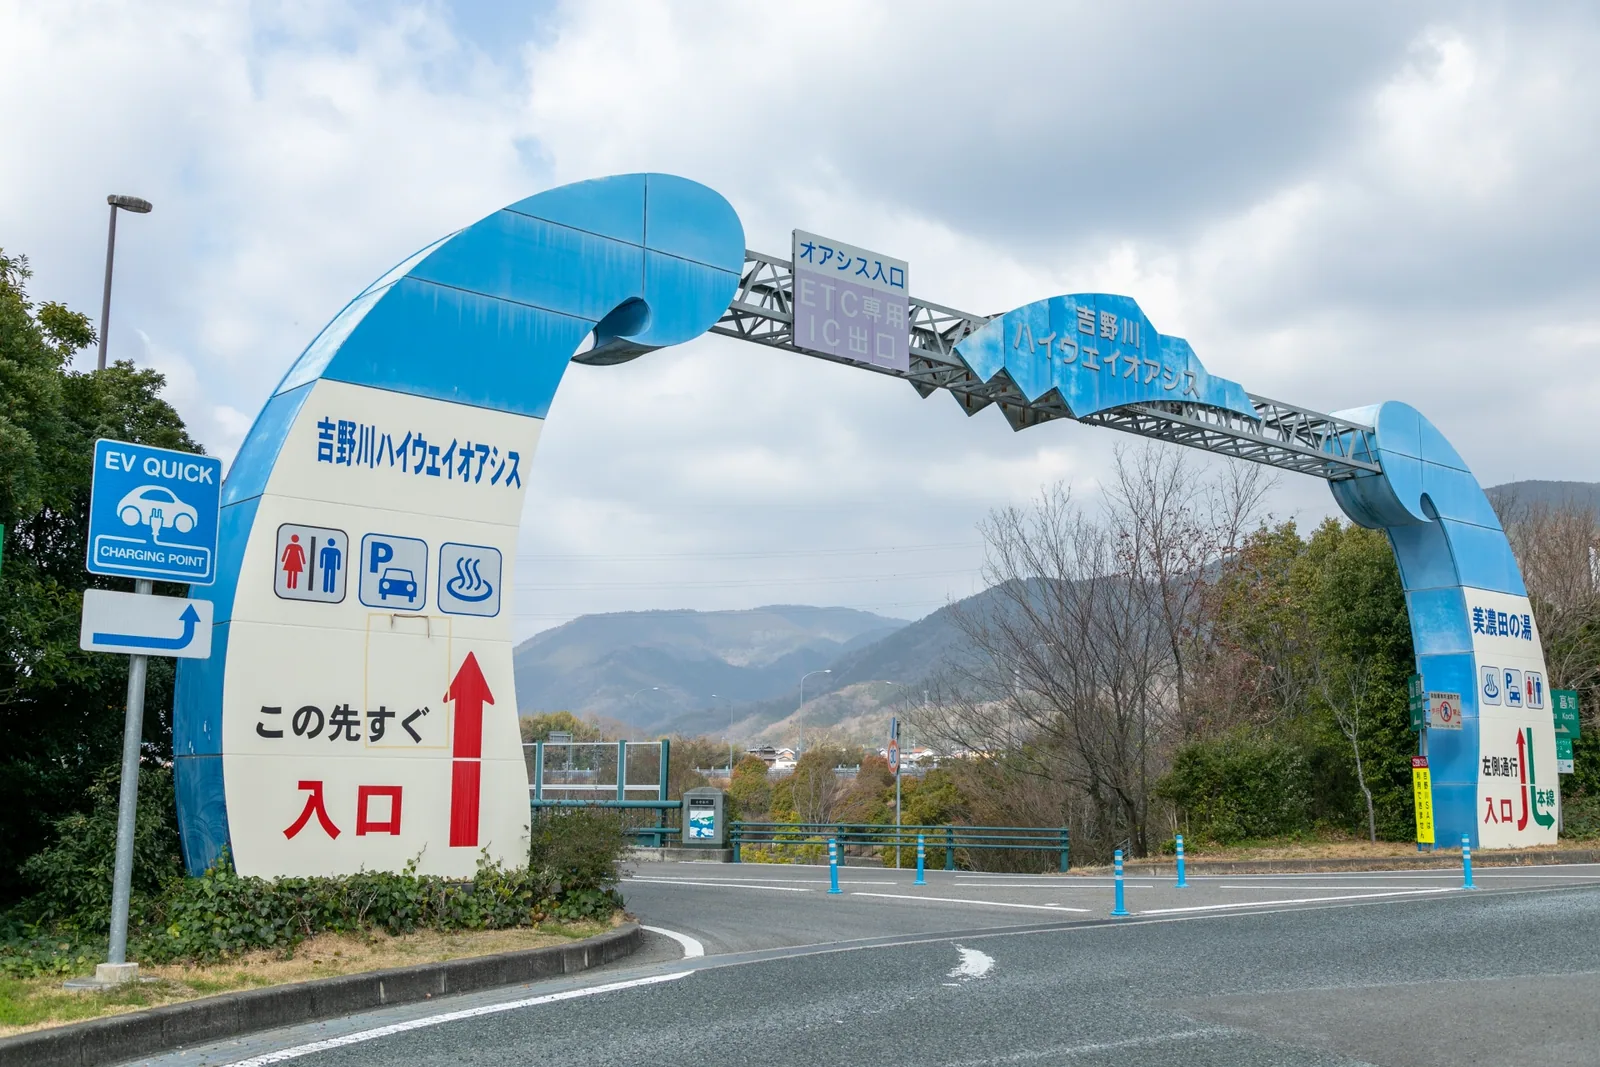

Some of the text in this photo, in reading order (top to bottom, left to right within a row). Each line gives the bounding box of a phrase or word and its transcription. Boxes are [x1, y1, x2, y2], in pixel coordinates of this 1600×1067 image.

[800, 241, 904, 289] オアシス入口
[800, 278, 904, 330] ETC専用
[810, 314, 896, 360] IC出口
[1076, 305, 1140, 349] 吉野川
[1013, 322, 1201, 399] ハイウェイオアシス
[105, 450, 213, 485] EV QUICK
[317, 416, 521, 490] 吉野川ハイウェイオアシス
[100, 546, 205, 567] CHARGING POINT
[369, 541, 394, 573] P
[1472, 606, 1532, 642] 美濃田の湯
[1505, 672, 1513, 690] P
[1559, 695, 1576, 710] 高知
[256, 703, 430, 744] この先すぐ
[1482, 755, 1518, 778] 左側通行
[283, 780, 403, 840] 入口
[1484, 797, 1513, 824] 入口
[1536, 788, 1556, 807] 本線
